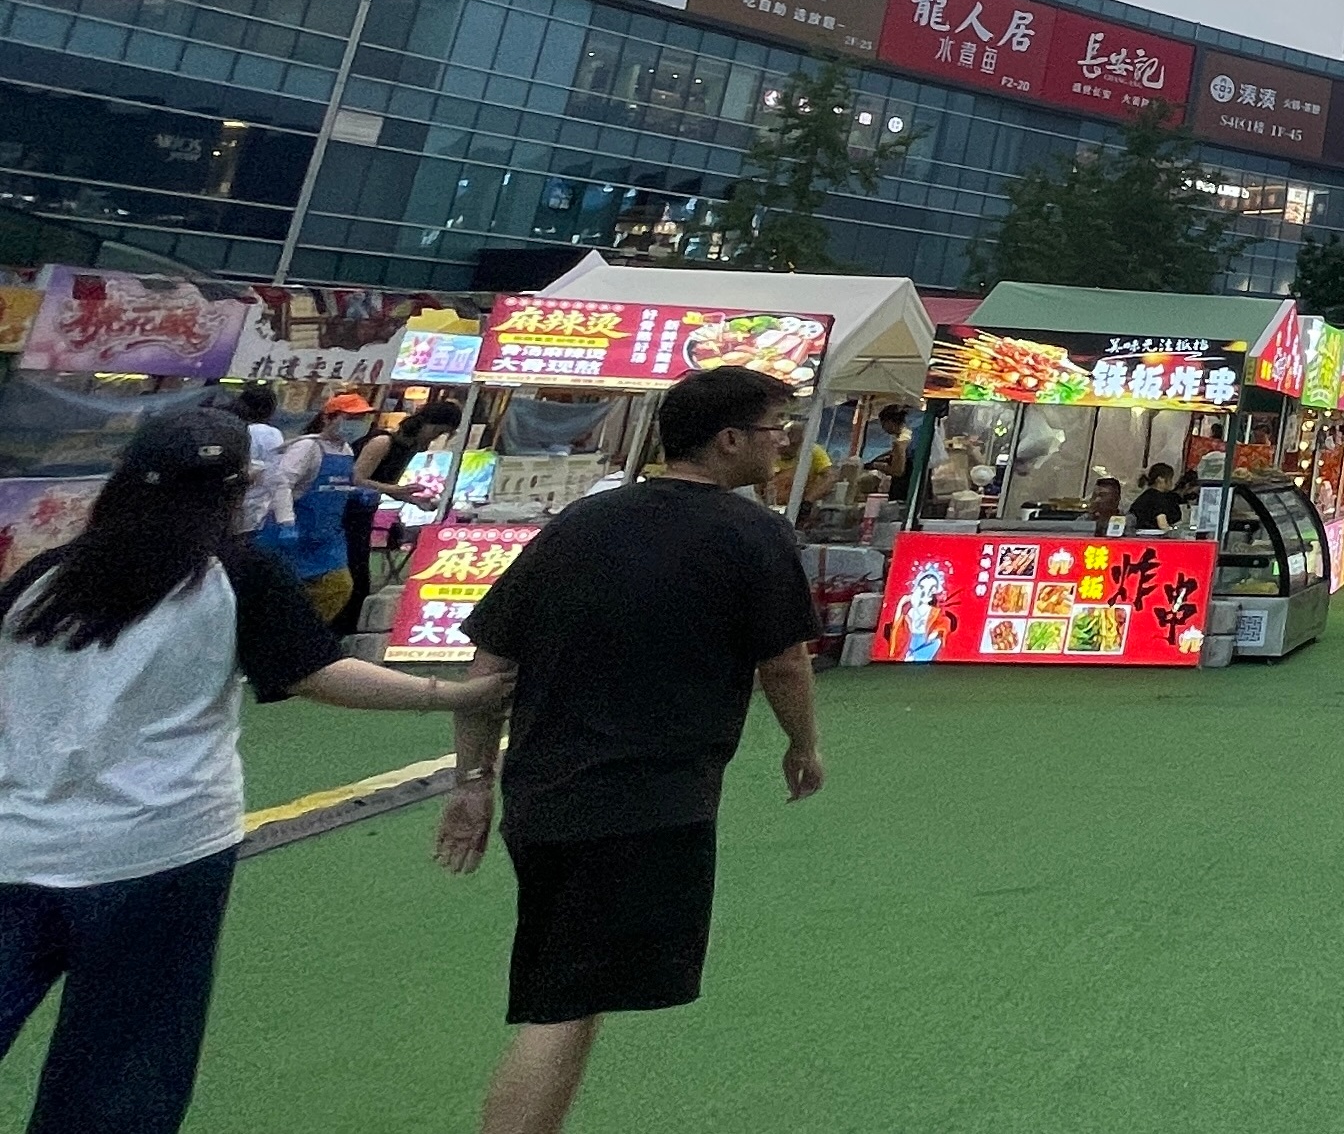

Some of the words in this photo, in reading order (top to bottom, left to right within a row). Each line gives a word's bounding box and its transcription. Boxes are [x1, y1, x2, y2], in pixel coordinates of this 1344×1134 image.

[490, 306, 633, 339] 麻辣烫
[1092, 359, 1237, 405] 铁板炸串
[1079, 545, 1109, 599] 铁板
[1107, 548, 1198, 645] 炸串
